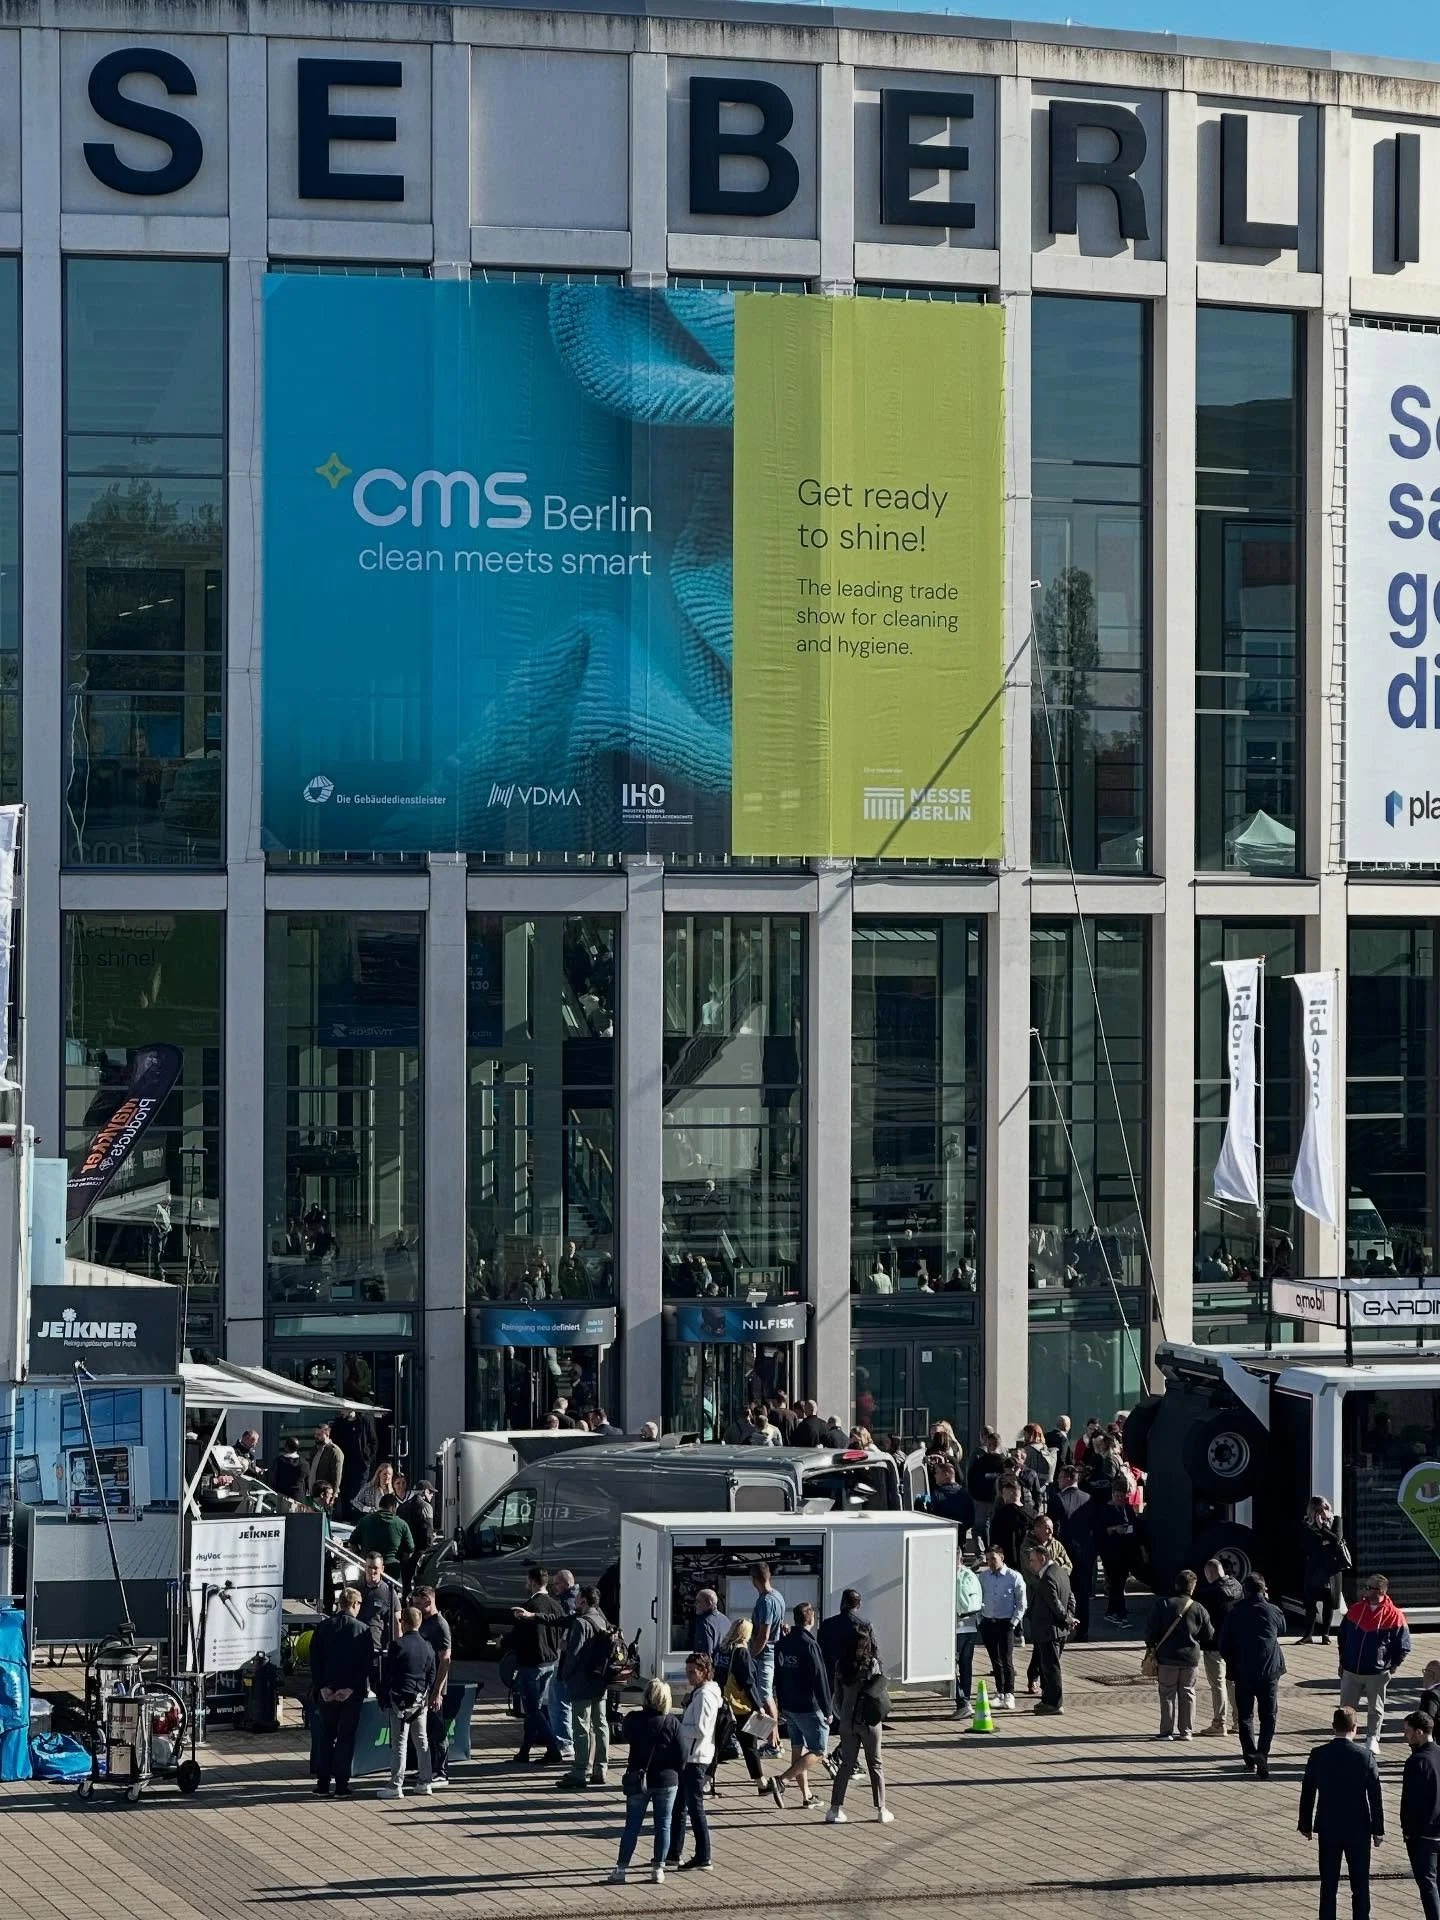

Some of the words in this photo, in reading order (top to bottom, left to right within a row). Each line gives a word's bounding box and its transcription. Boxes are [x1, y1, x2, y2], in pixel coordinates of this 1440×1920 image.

[83, 47, 405, 201] SE
[689, 77, 1421, 264] BERLI
[1389, 384, 1440, 460] S
[353, 468, 532, 529] cms
[544, 495, 652, 532] Berlin
[798, 478, 853, 508] Get
[864, 483, 949, 518] ready
[797, 524, 829, 550] to
[840, 522, 926, 552] shine!
[359, 541, 443, 571] clean
[454, 549, 553, 573] meets
[561, 550, 652, 576] smart
[797, 577, 832, 596] The
[838, 579, 903, 603] leading
[909, 583, 959, 600] trade
[797, 608, 845, 625] show
[852, 608, 876, 626] for
[883, 610, 959, 633] cleaning
[1388, 571, 1440, 648] g
[797, 635, 832, 653] and
[838, 636, 913, 658] hygiene.
[337, 794, 351, 804] Die
[355, 794, 447, 805] Gebäudedienstleister
[517, 788, 582, 807] VDMA
[622, 783, 665, 807] IHO
[910, 788, 971, 803] MESSE
[910, 806, 971, 821] BERLIN
[38, 1310, 138, 1339] JEIKNER
[551, 1323, 581, 1331] definiert
[743, 1318, 795, 1330] NILFISK
[239, 1526, 281, 1540] JEIKNER
